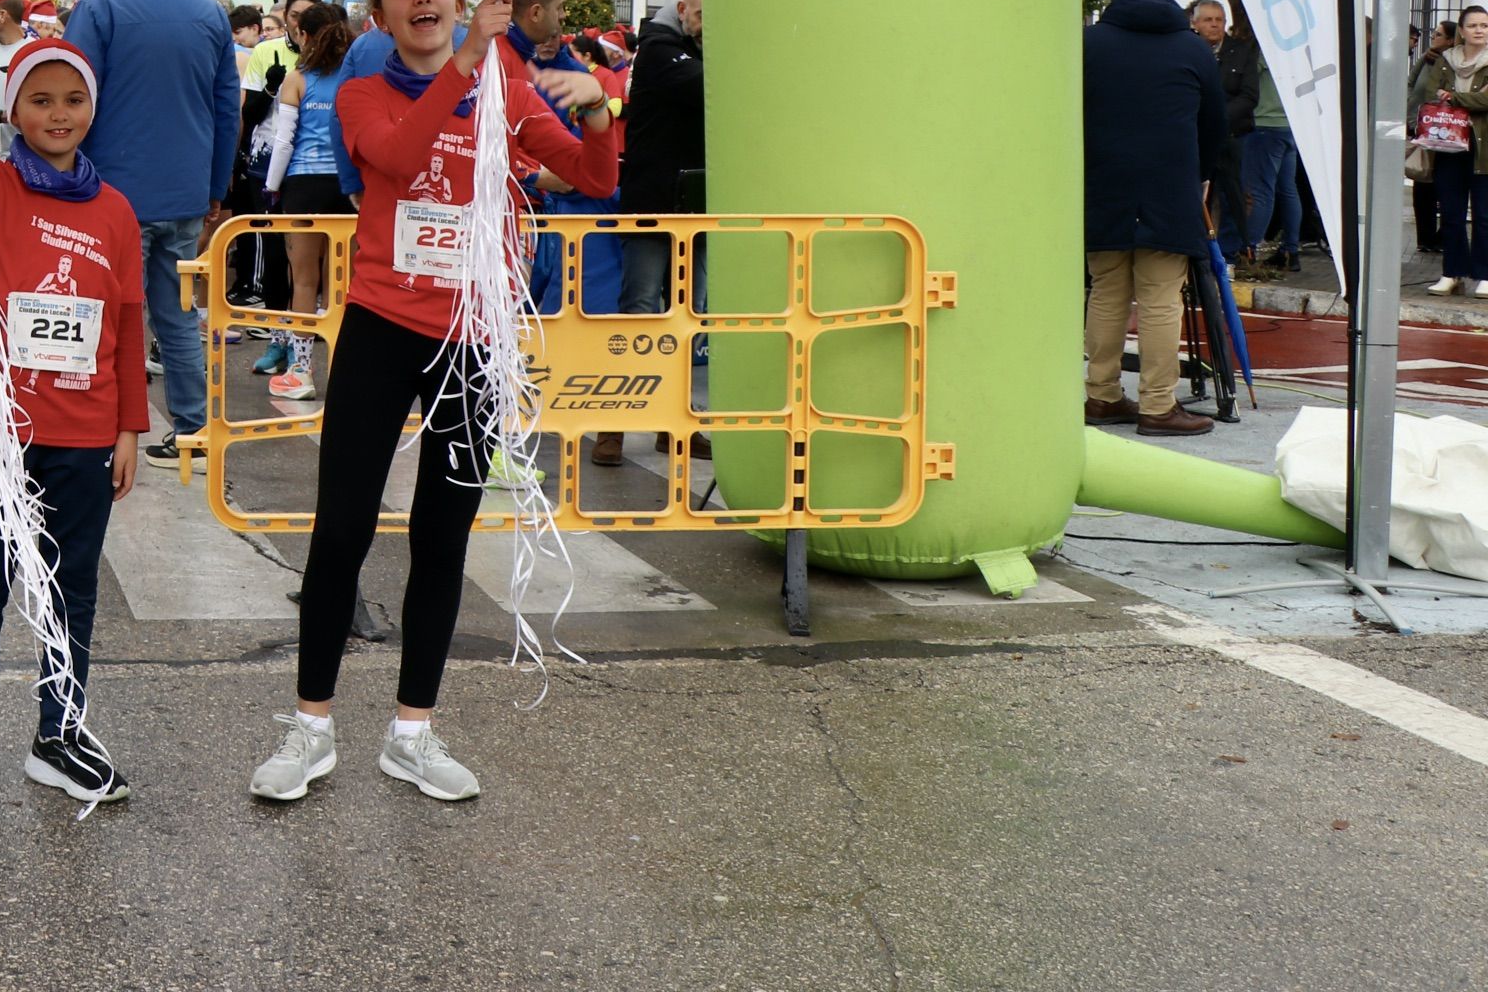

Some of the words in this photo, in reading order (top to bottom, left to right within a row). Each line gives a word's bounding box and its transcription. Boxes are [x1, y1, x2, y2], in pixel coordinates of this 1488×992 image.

[438, 132, 464, 145] estre
[443, 142, 456, 154] de
[407, 214, 429, 223] Ciudad
[31, 215, 37, 227] I
[37, 217, 54, 234] San
[54, 224, 96, 246] Silvestre
[40, 231, 74, 252] Ciudad
[73, 242, 86, 256] de
[30, 318, 85, 343] 221
[549, 397, 649, 410] Lucena
